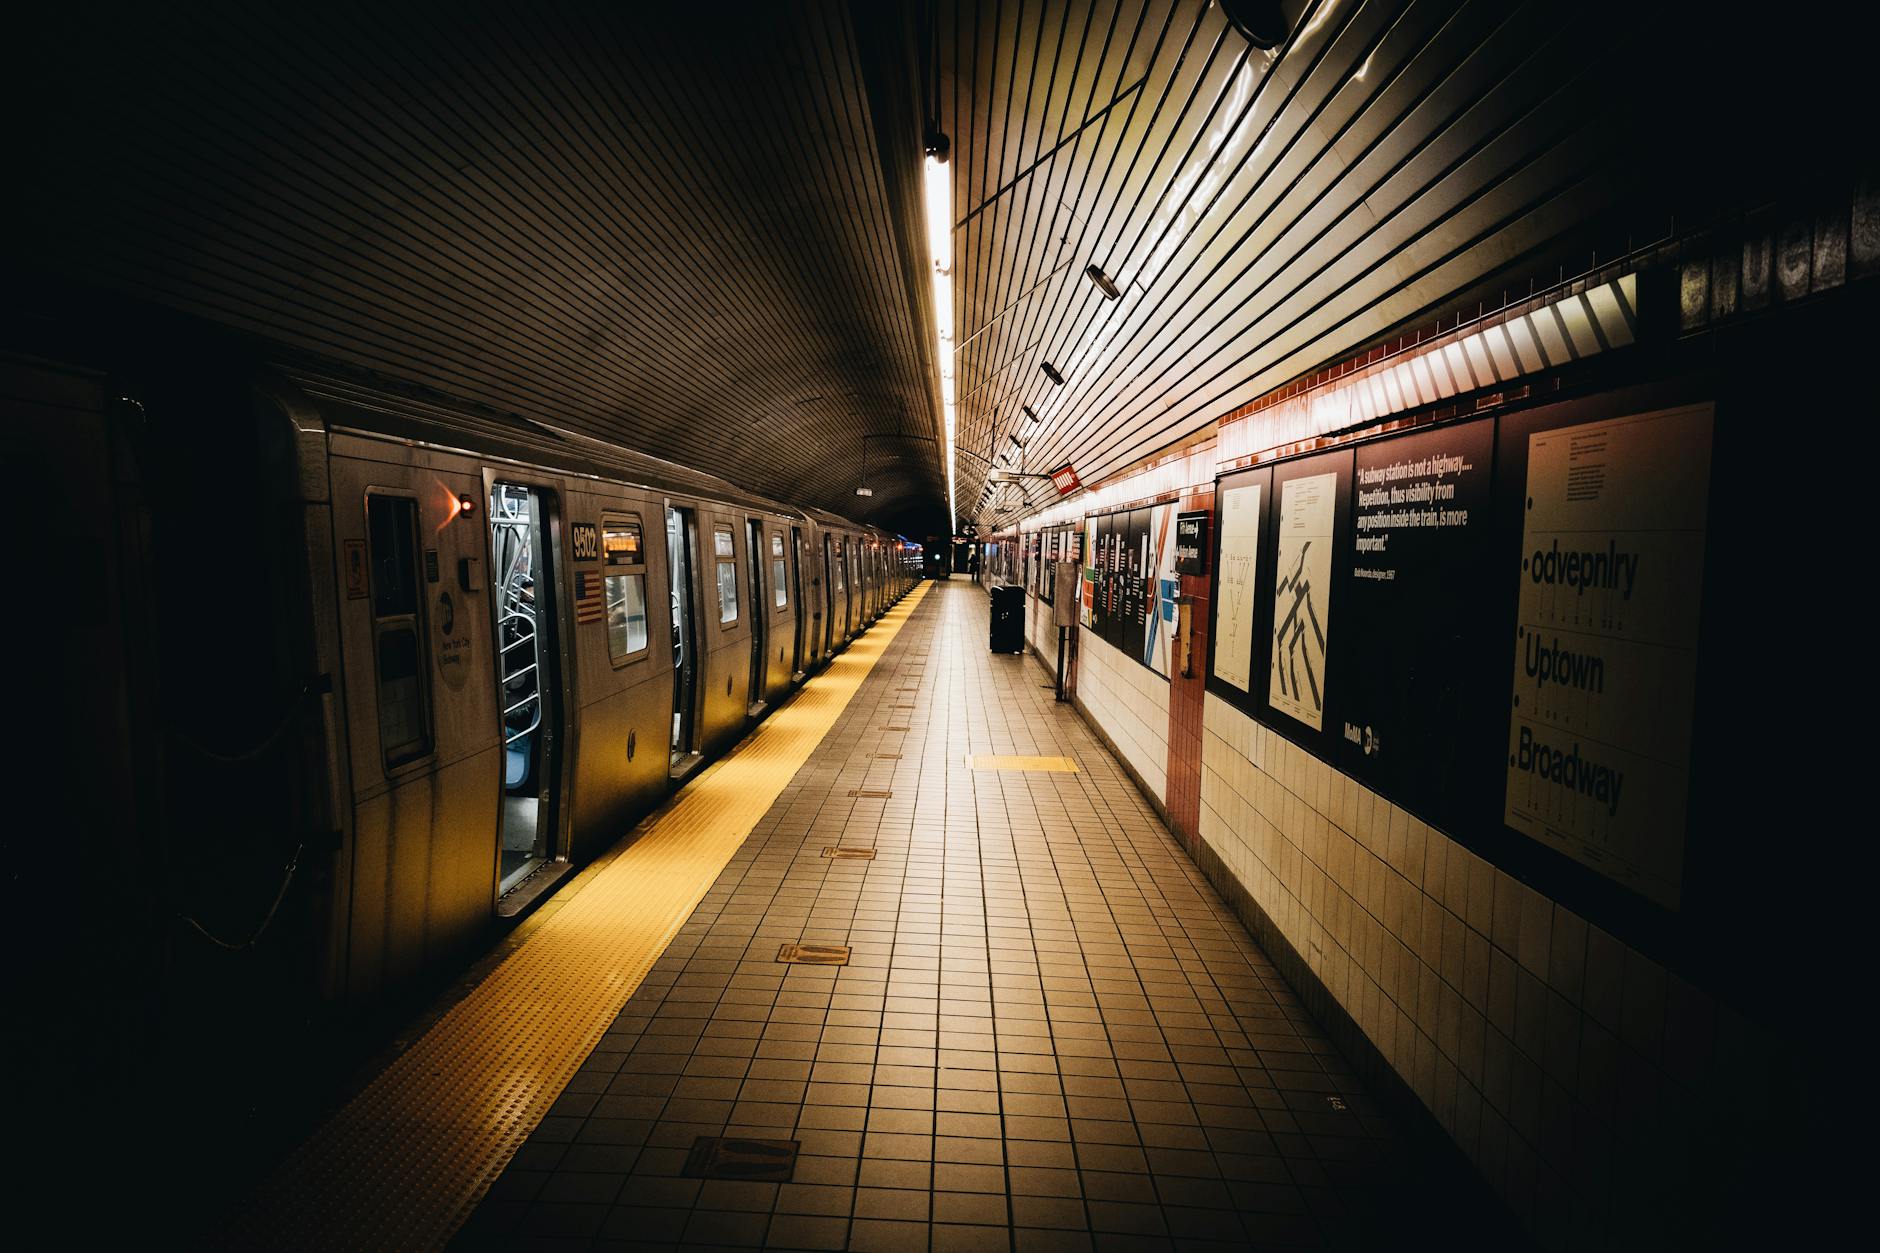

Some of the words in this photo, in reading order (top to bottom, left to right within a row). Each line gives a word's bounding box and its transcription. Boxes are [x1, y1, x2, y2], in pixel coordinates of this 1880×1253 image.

[1365, 466, 1385, 485] subway
[1386, 461, 1408, 481] station
[1408, 459, 1414, 478] is
[1414, 458, 1427, 476] not
[1427, 461, 1432, 475] a
[1358, 487, 1390, 509] Repetition,
[1391, 485, 1405, 504] thus
[1406, 482, 1434, 505] visibility
[1435, 481, 1454, 500] from
[1357, 514, 1367, 532] any
[1367, 510, 1391, 532] position
[1391, 509, 1409, 527] inside
[1409, 508, 1420, 527] the
[1421, 507, 1438, 530] train,
[1440, 506, 1446, 526] is
[1447, 509, 1468, 526] more
[573, 526, 597, 558] 9502
[1531, 539, 1639, 600] odvepnlry
[1525, 633, 1605, 693] Uptown
[1518, 726, 1624, 817] Broadway
